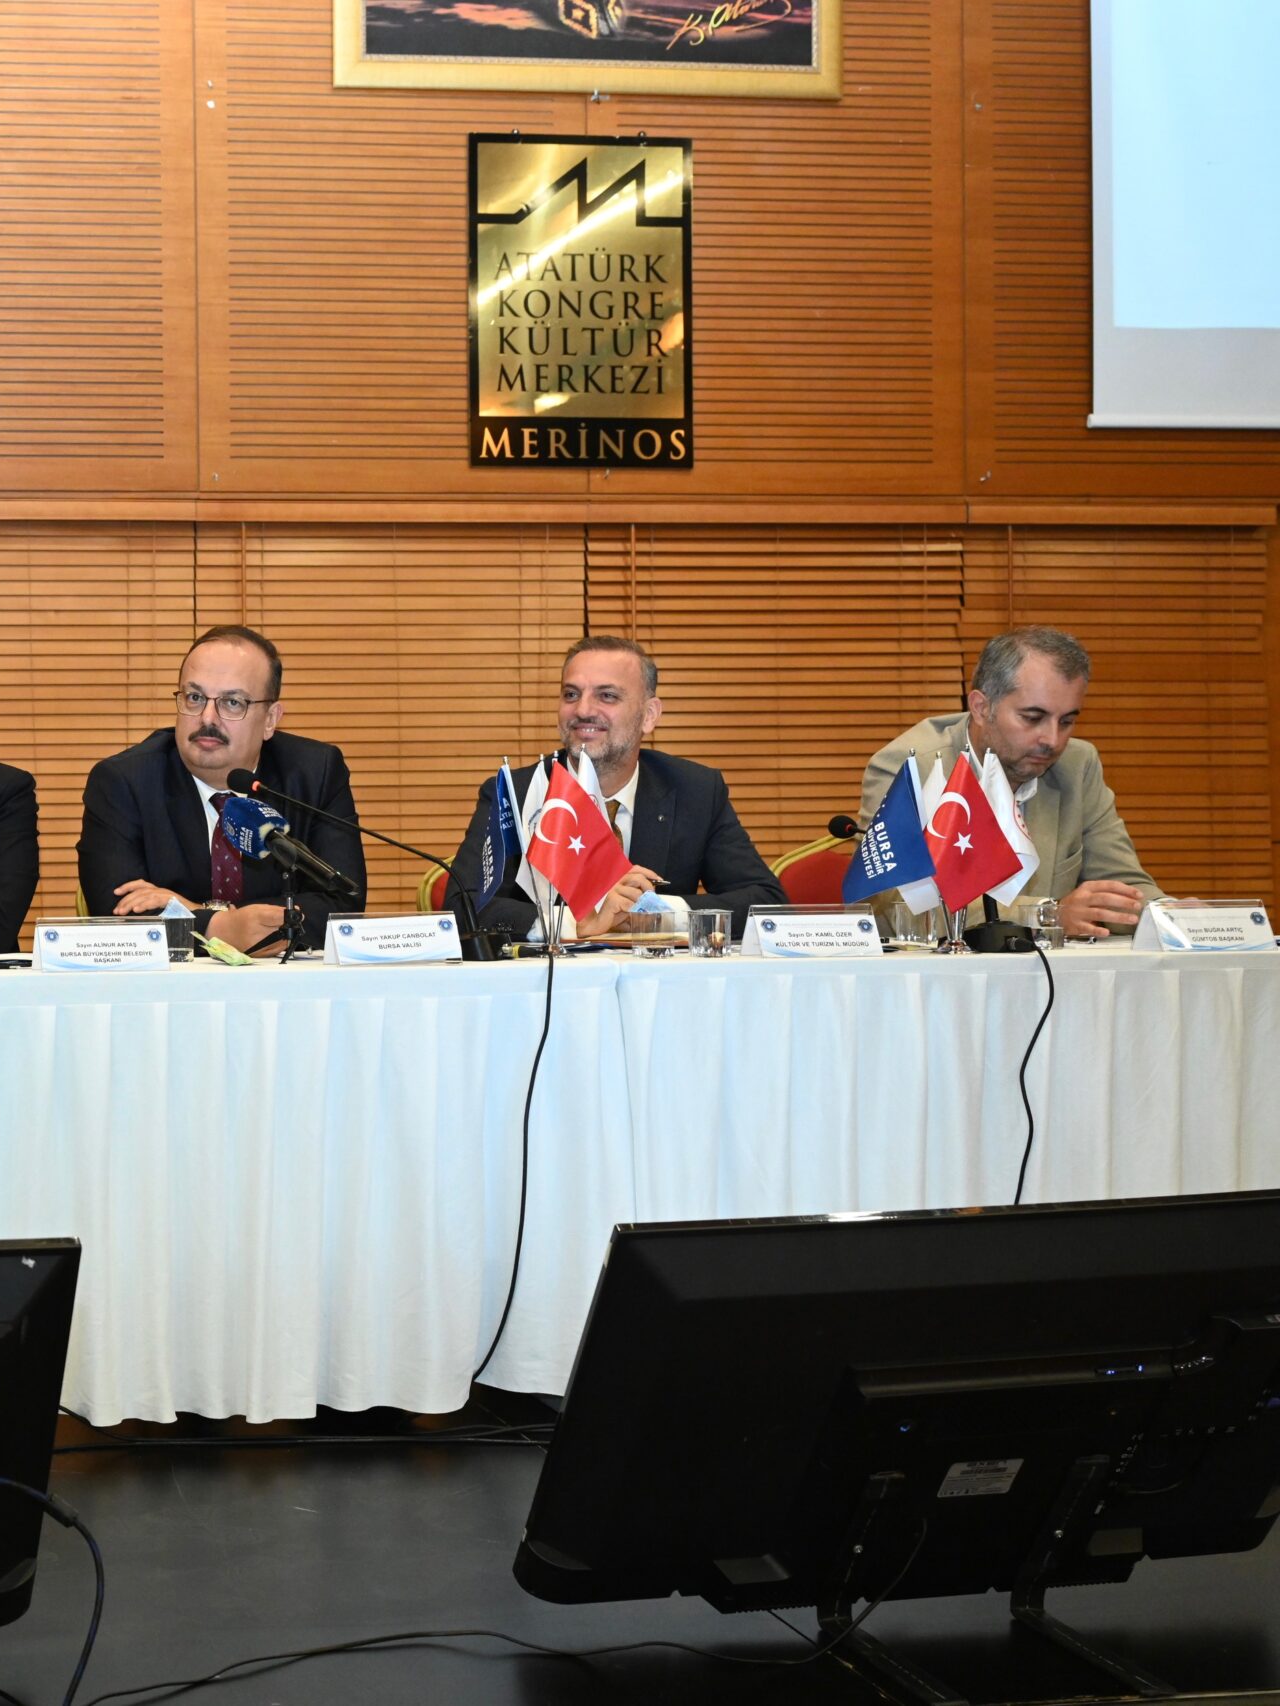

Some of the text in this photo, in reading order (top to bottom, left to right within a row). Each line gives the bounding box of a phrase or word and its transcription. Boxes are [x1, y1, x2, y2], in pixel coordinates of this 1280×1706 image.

[494, 247, 669, 284] ATATÜRK
[498, 289, 665, 322] KONGRE
[498, 320, 670, 358] KÜLTÜR
[496, 359, 665, 395] MERKEZİ
[479, 422, 687, 461] MERİNOS
[874, 821, 897, 872] BURSA
